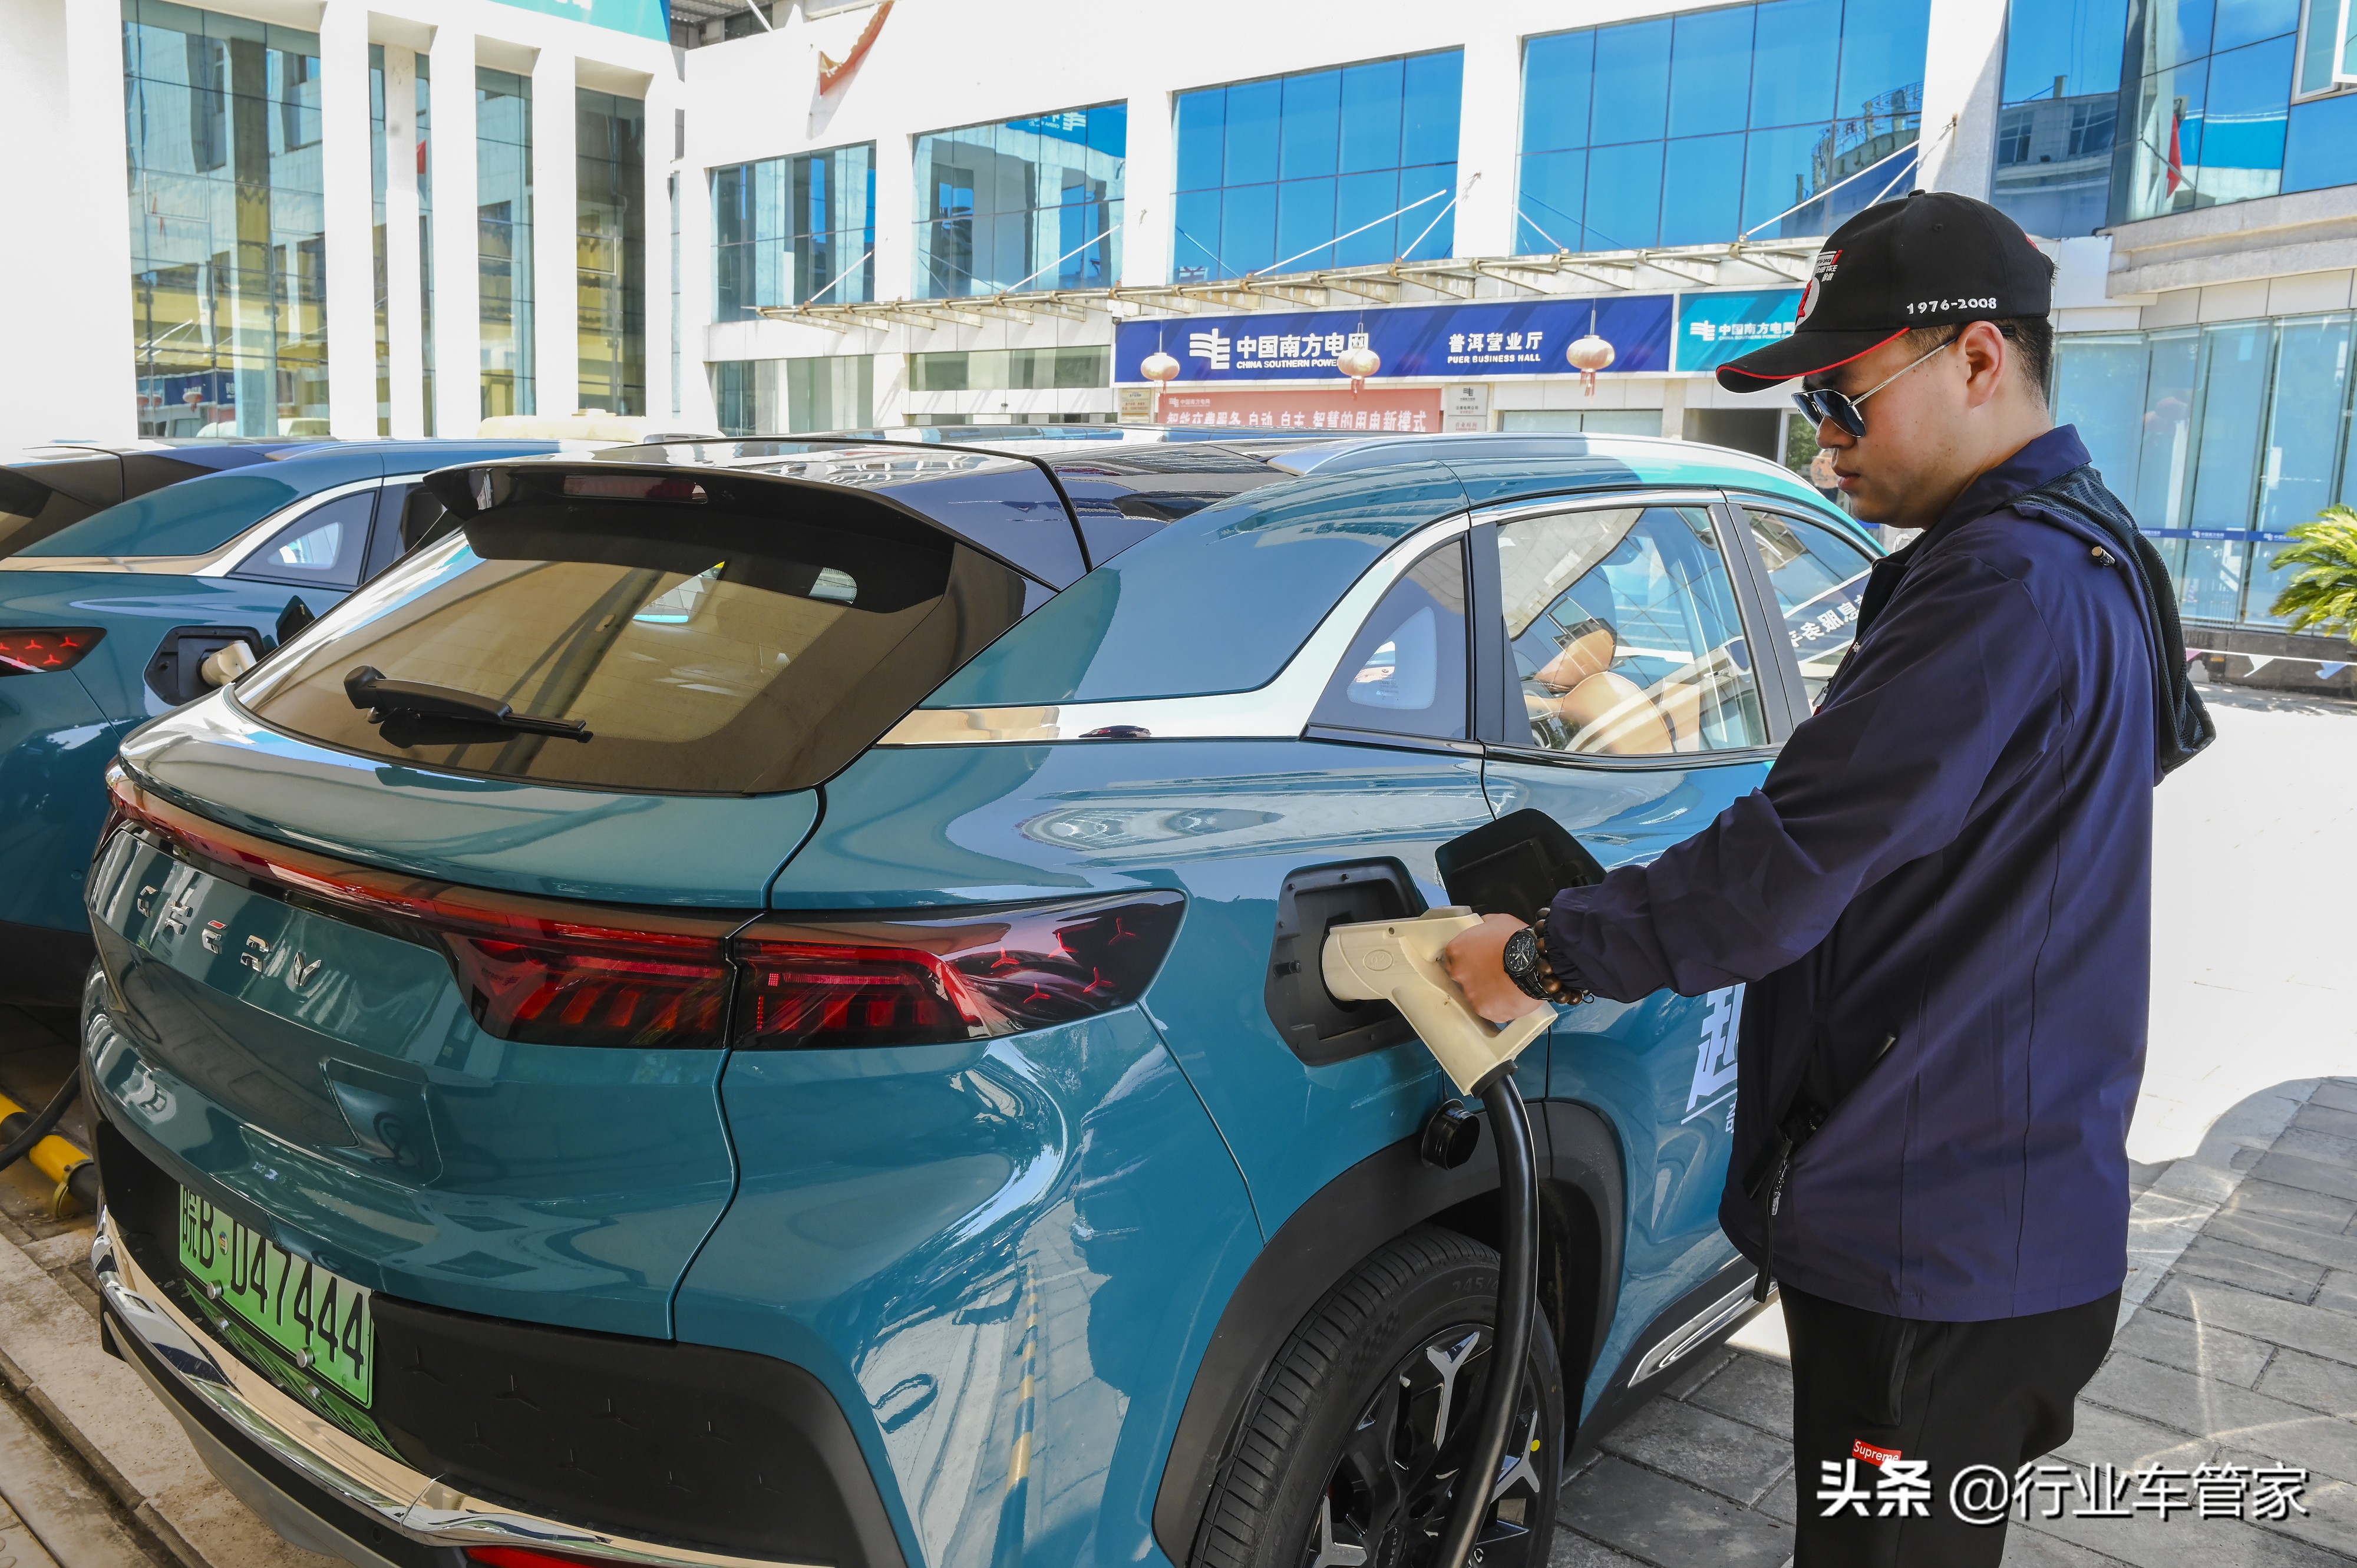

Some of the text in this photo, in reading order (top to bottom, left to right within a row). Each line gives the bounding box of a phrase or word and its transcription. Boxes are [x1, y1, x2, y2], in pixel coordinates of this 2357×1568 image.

[1907, 297, 1997, 315] 1976-2008
[1718, 322, 1795, 336] 中国南方电网
[1237, 332, 1369, 359] 中国南方电网
[1448, 331, 1543, 353] 普洱营业厅
[1236, 358, 1338, 369] CHINA SOUTHERN POWE
[1448, 354, 1541, 364] PUER BUSINESS HALL
[137, 884, 322, 988] CHERY
